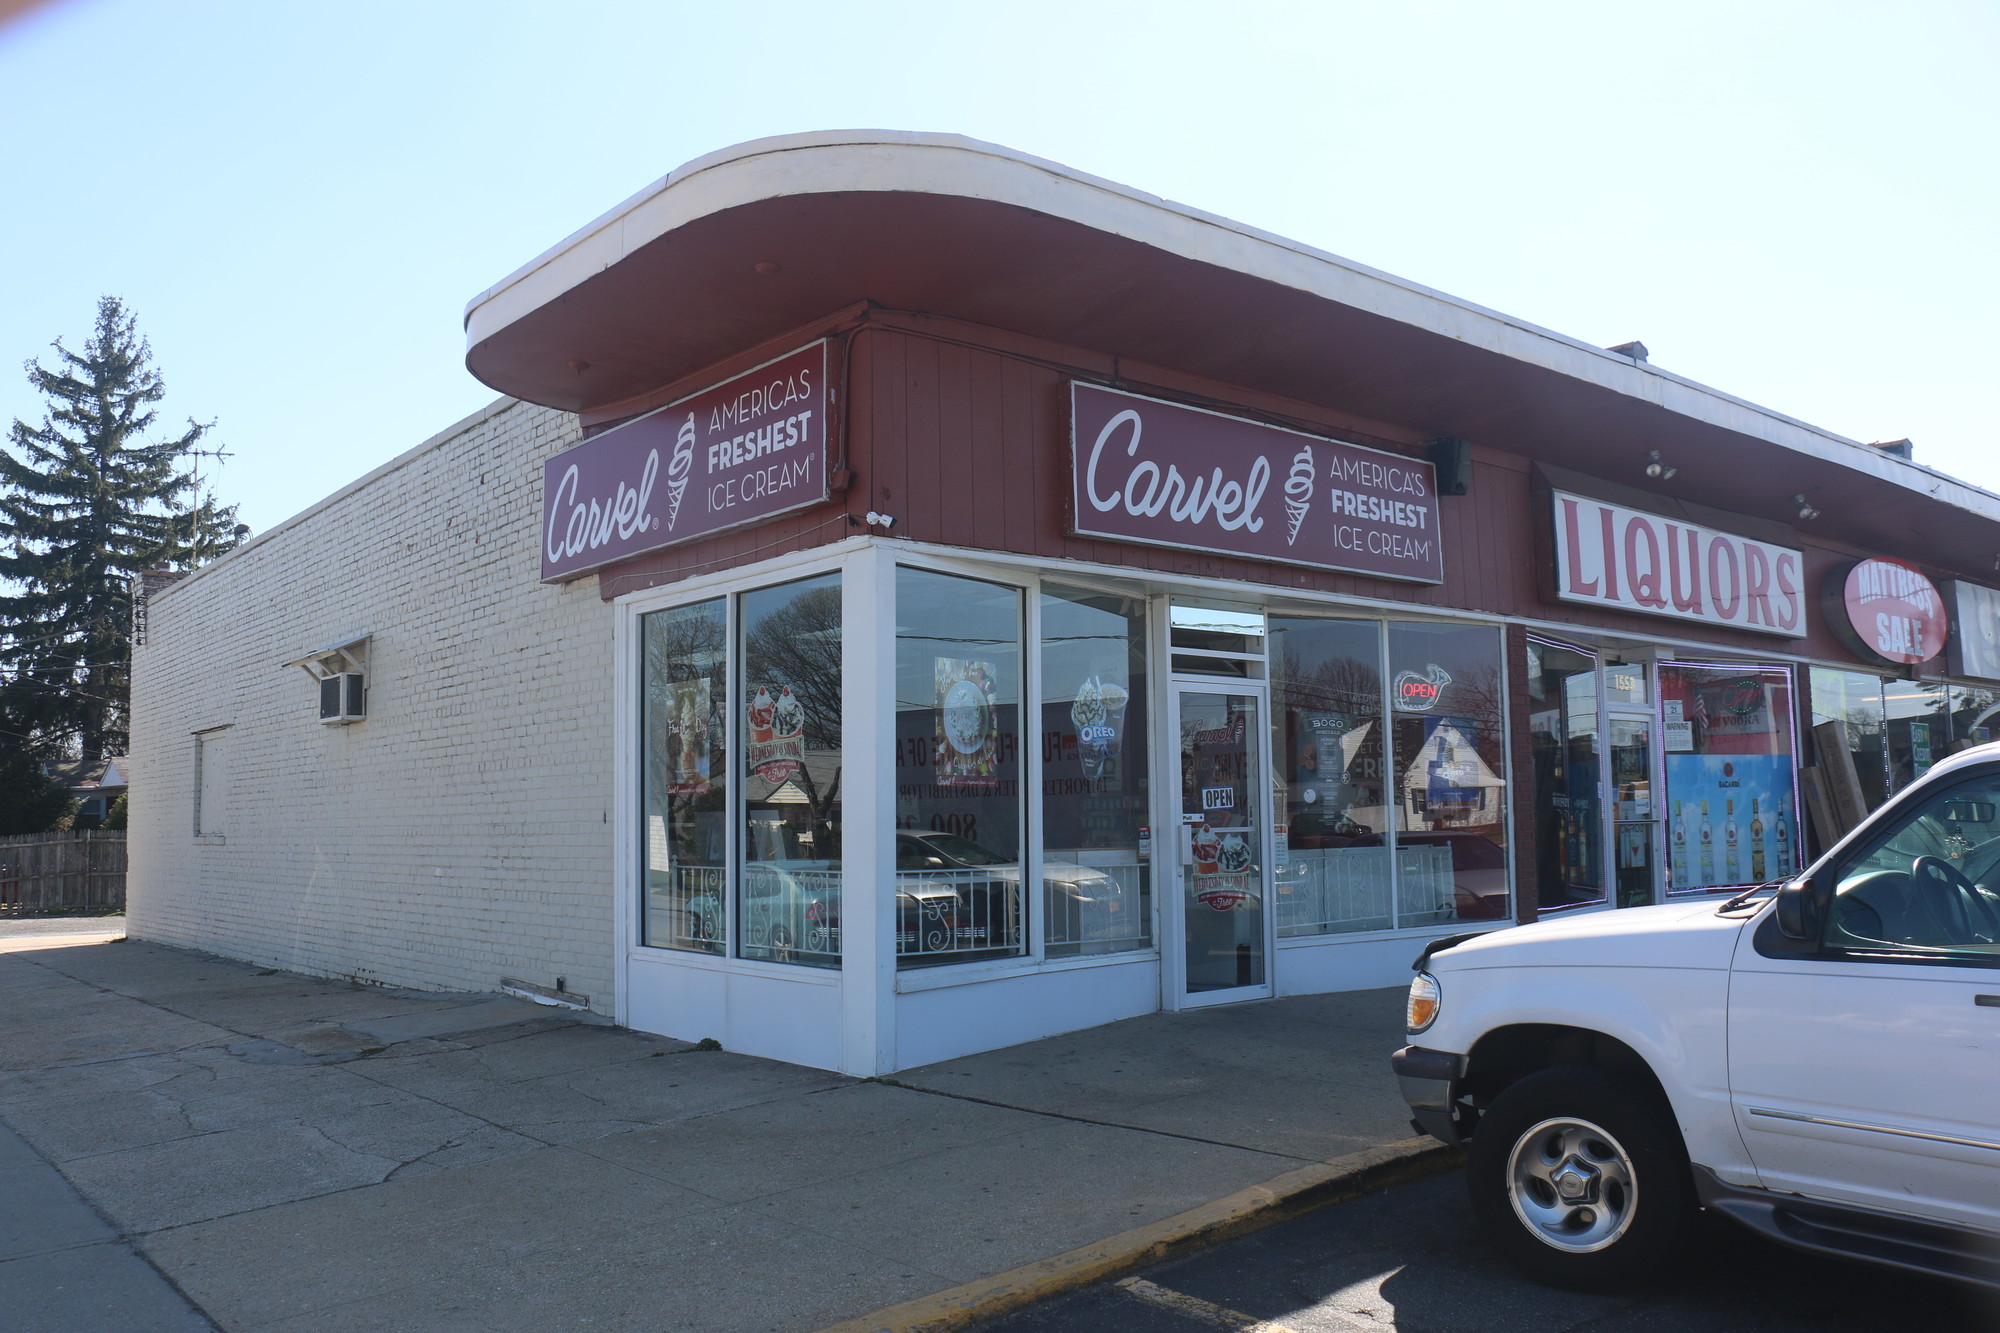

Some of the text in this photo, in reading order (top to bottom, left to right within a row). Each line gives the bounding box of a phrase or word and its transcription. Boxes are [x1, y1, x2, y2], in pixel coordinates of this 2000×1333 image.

[708, 369, 811, 435] AMERICAS
[708, 410, 812, 474] FRESHEST
[1086, 409, 1271, 533] Carvel
[1330, 455, 1426, 497] AMERICA'S
[547, 448, 659, 563] Carvel
[707, 482, 736, 513] ICE
[1331, 489, 1428, 530] FRESHEST
[1333, 523, 1364, 552] ICE
[1561, 498, 1799, 631] LIQUORS
[1858, 561, 1934, 619] MATTRESS
[1876, 612, 1924, 657] SALE
[1403, 683, 1437, 698] OPEN
[1081, 726, 1115, 742] OREO
[1191, 718, 1233, 743] Carvel
[1312, 719, 1344, 728] BOGO
[1665, 722, 1689, 731] WARNING
[1722, 715, 1760, 726] VODKA
[1205, 788, 1233, 808] OPEN
[1217, 898, 1233, 909] Free
